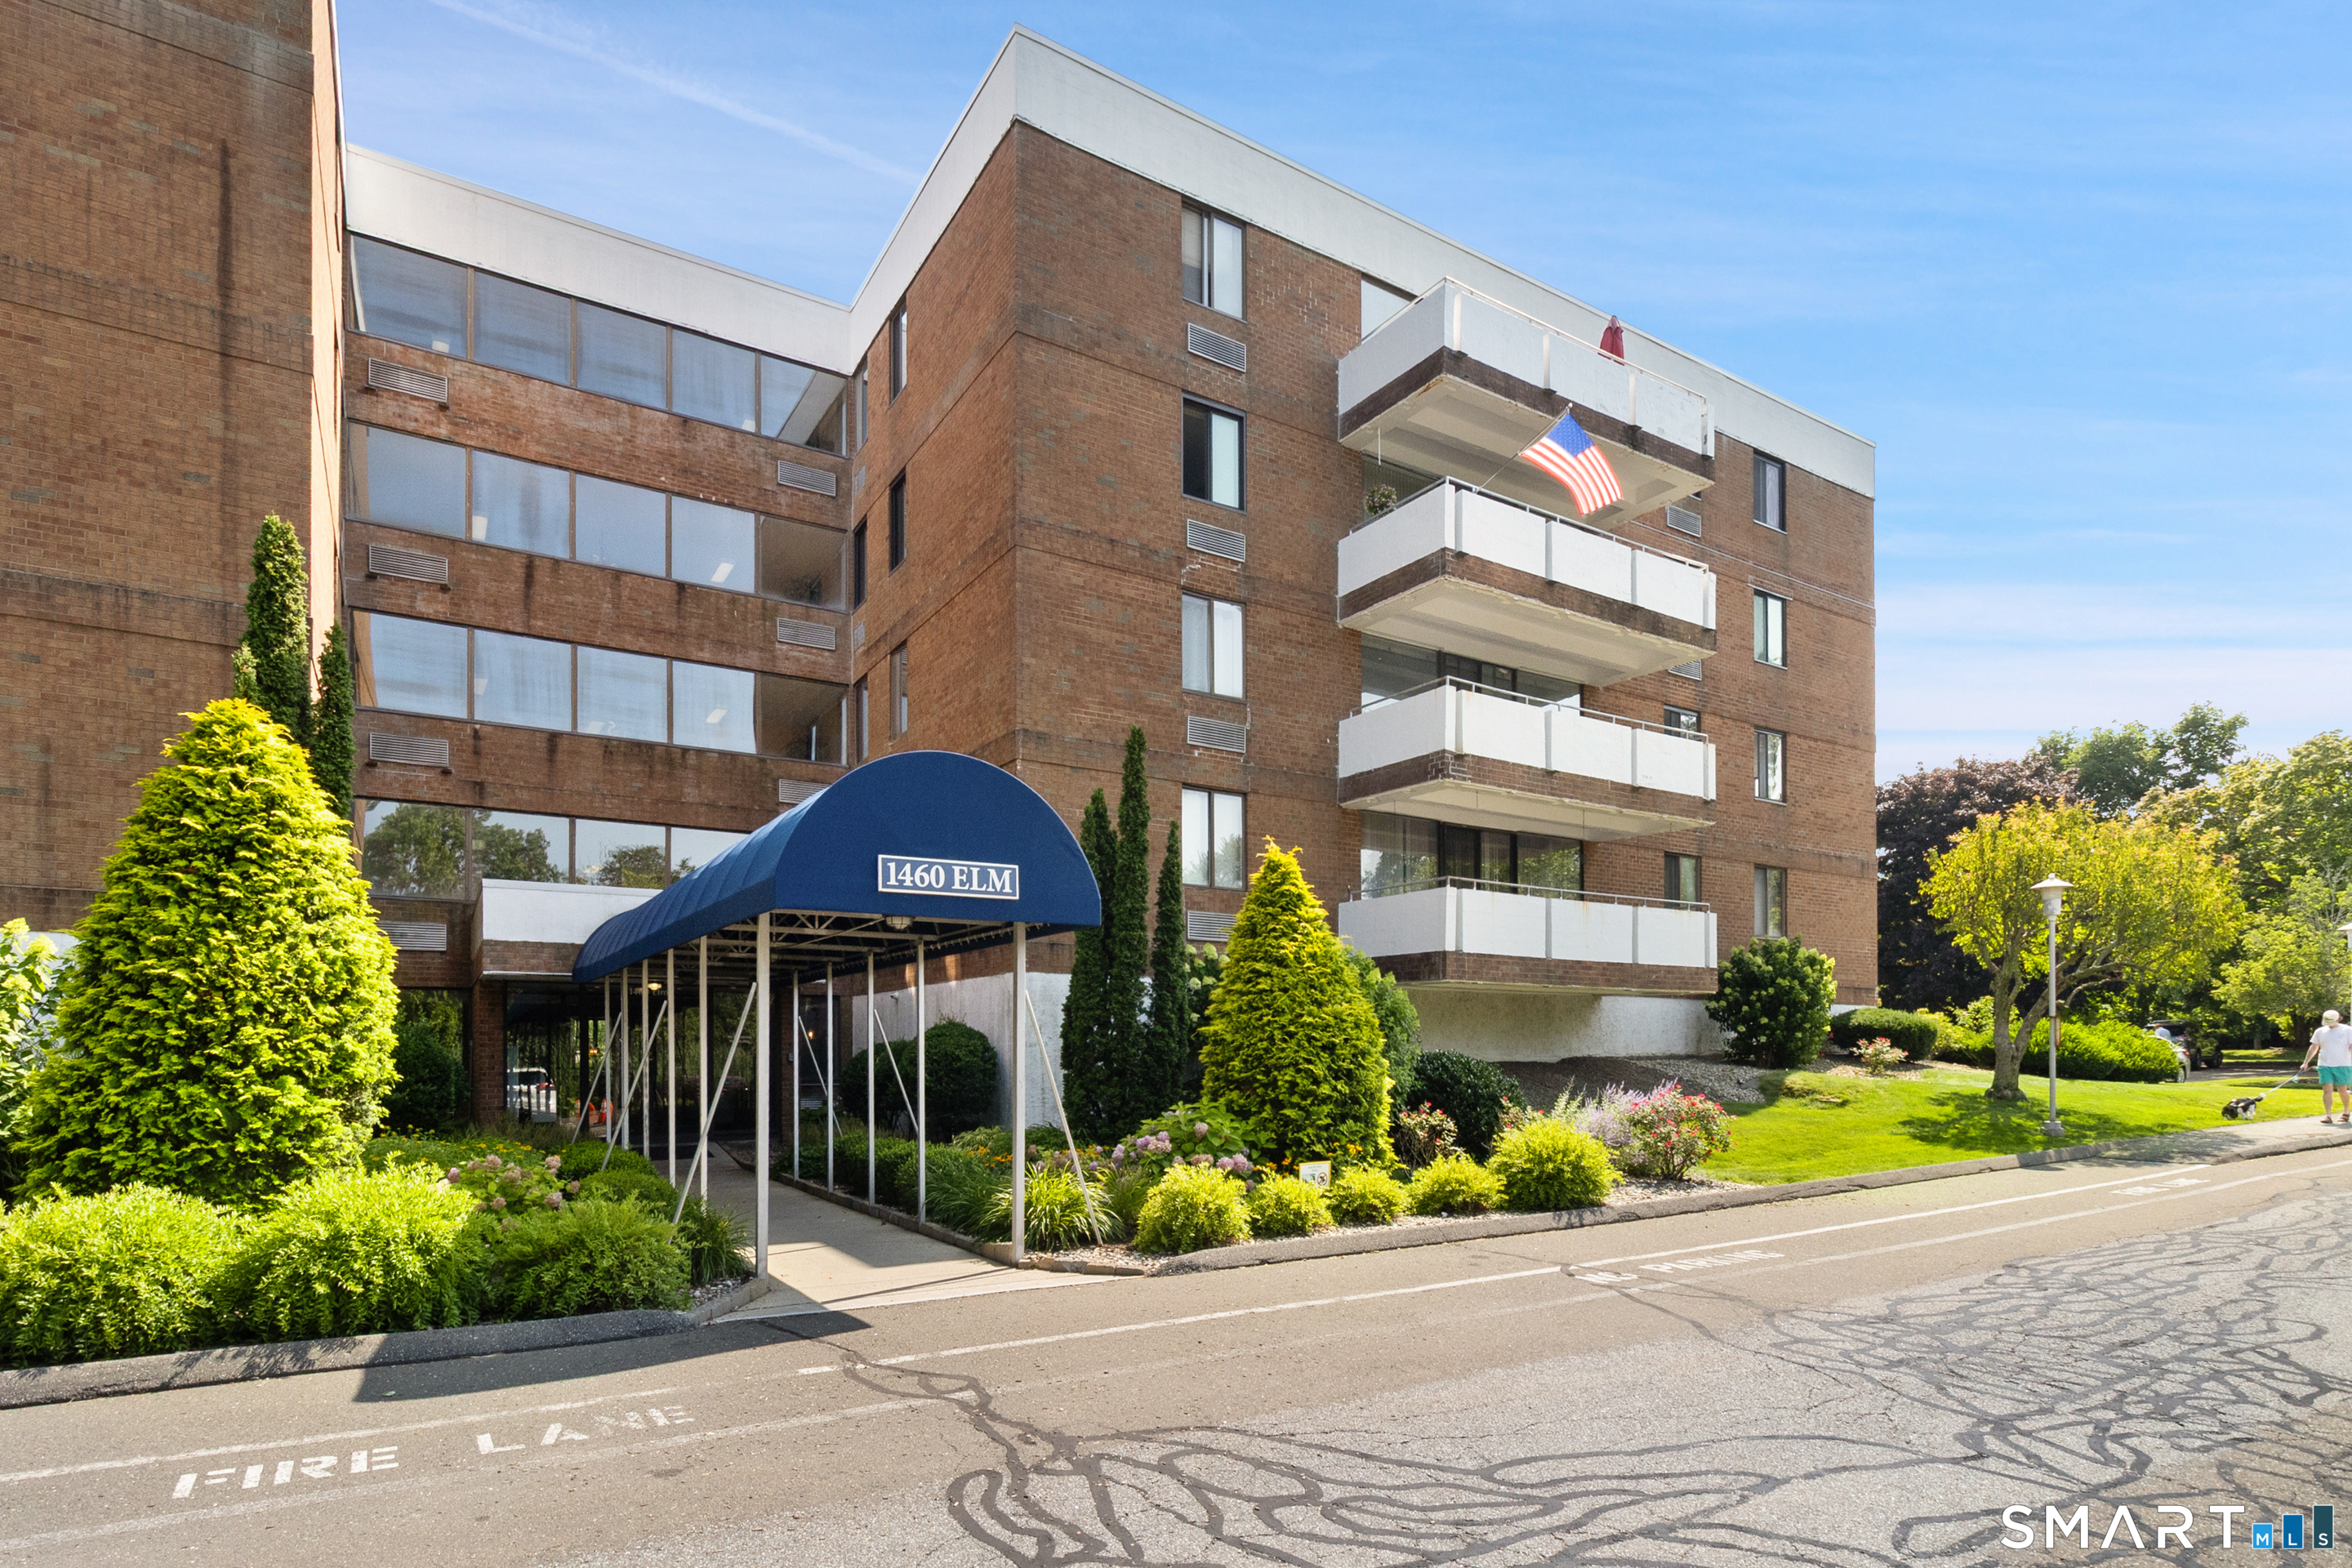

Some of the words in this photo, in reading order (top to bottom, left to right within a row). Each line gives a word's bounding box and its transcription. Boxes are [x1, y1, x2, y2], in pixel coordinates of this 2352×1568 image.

[886, 862, 946, 889] 1460
[951, 865, 1013, 893] ELM
[1638, 1250, 1784, 1273] PARKING
[172, 1446, 399, 1499] FIRE
